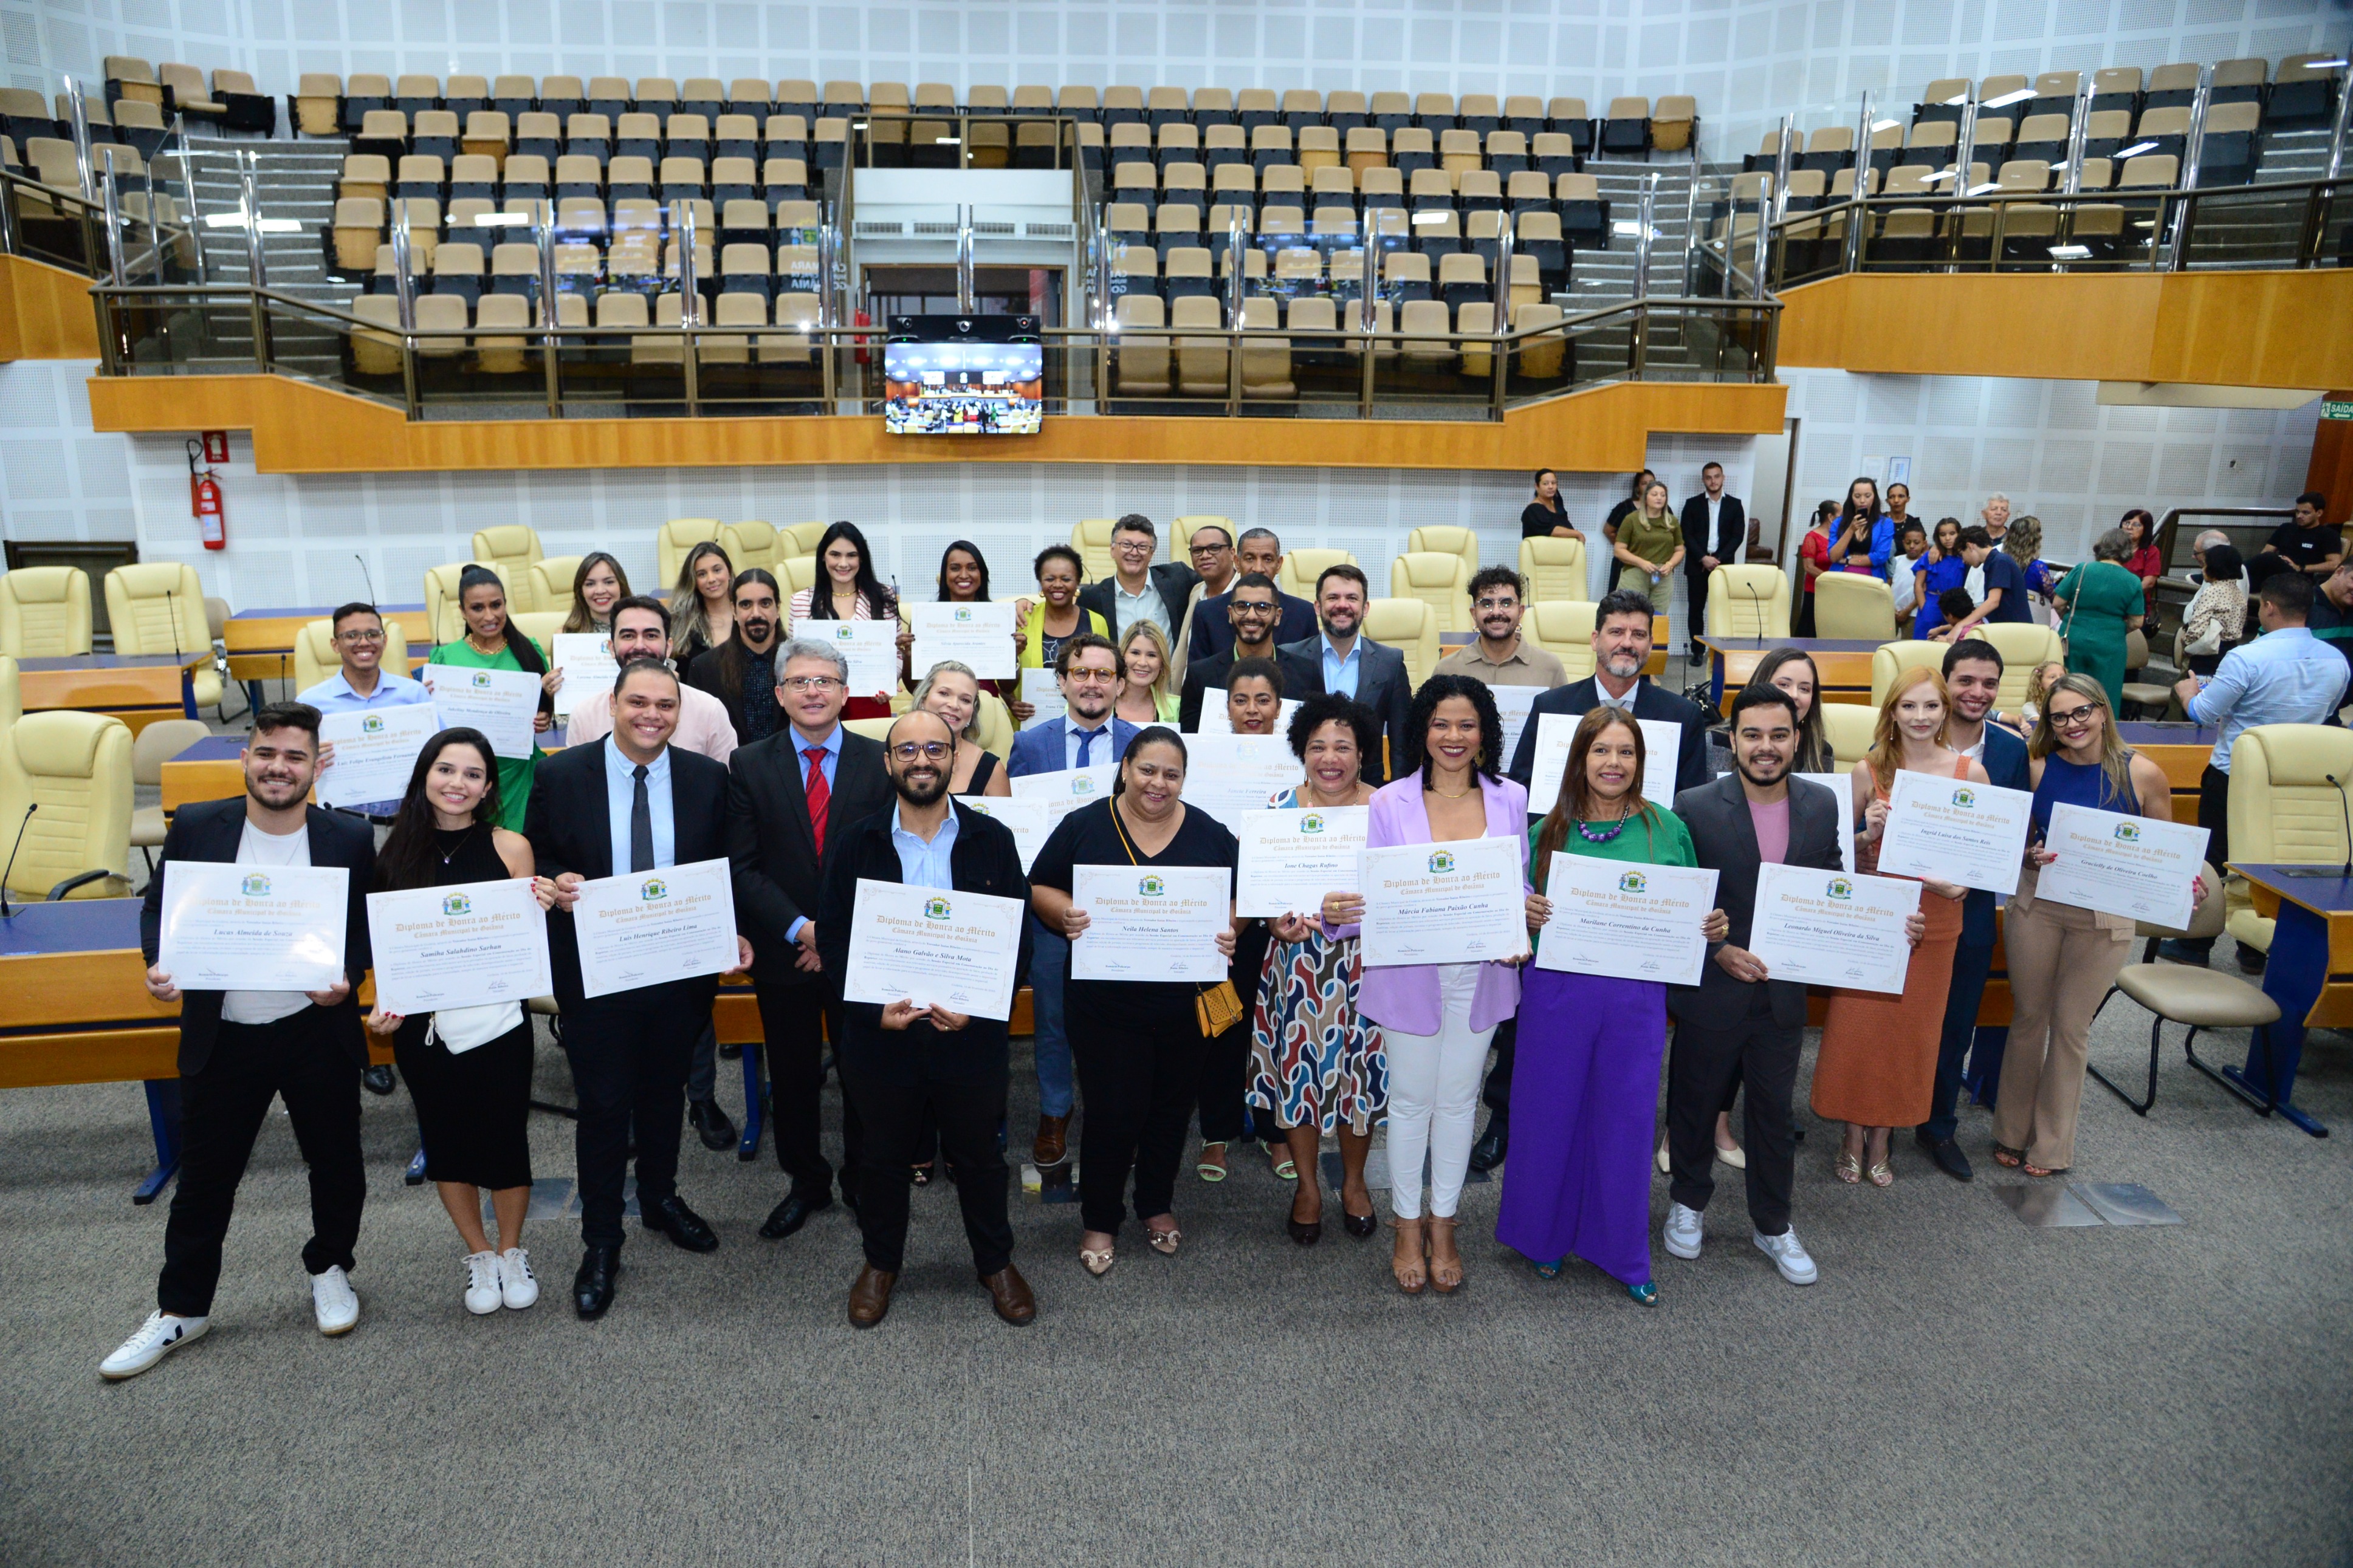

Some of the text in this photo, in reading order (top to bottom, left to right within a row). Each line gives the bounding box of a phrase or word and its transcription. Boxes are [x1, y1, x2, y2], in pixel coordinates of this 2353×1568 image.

[2331, 402, 2353, 413] SAÍDA
[1911, 800, 1942, 813] Diploma
[1953, 808, 1975, 819] Honra
[1985, 814, 2010, 824] Mérito
[1259, 837, 1291, 845] Diploma
[1339, 834, 1365, 843] Mérito
[2069, 831, 2103, 845] Diploma
[2115, 841, 2140, 852] Honra
[2152, 849, 2180, 860] Mérito
[1384, 879, 1419, 889] Diploma
[1432, 876, 1459, 885] Honra
[1472, 871, 1500, 882] Mérito
[1424, 885, 1454, 894] Municipal
[1095, 897, 1129, 906] Diploma
[1142, 898, 1167, 907] Honra
[1180, 899, 1207, 908] Mérito
[1571, 888, 1607, 900] Diploma
[1621, 894, 1647, 904] Honra
[1660, 899, 1690, 909] Mérito
[1781, 893, 1815, 906] Diploma
[1828, 900, 1853, 911] Honra
[1865, 906, 1894, 917] Mérito
[599, 908, 634, 919] Diploma
[646, 902, 672, 911] Honra
[685, 894, 712, 905] Mérito
[1610, 903, 1640, 911] Municipal
[396, 923, 434, 933] Diploma
[448, 918, 476, 927] Honra
[491, 911, 521, 923] Mérito
[877, 914, 912, 927] Diploma
[915, 920, 924, 928] de
[927, 920, 953, 932] Honra
[966, 926, 995, 937] Mérito
[1581, 918, 1608, 926] Marilane
[1609, 922, 1641, 931] Correntino
[1784, 923, 1812, 932] Leonardo
[634, 931, 661, 940] Henrique
[892, 927, 915, 936] Câmara
[916, 930, 946, 939] Municipal
[955, 935, 978, 943] Goiânia
[446, 947, 478, 956] Salahdino
